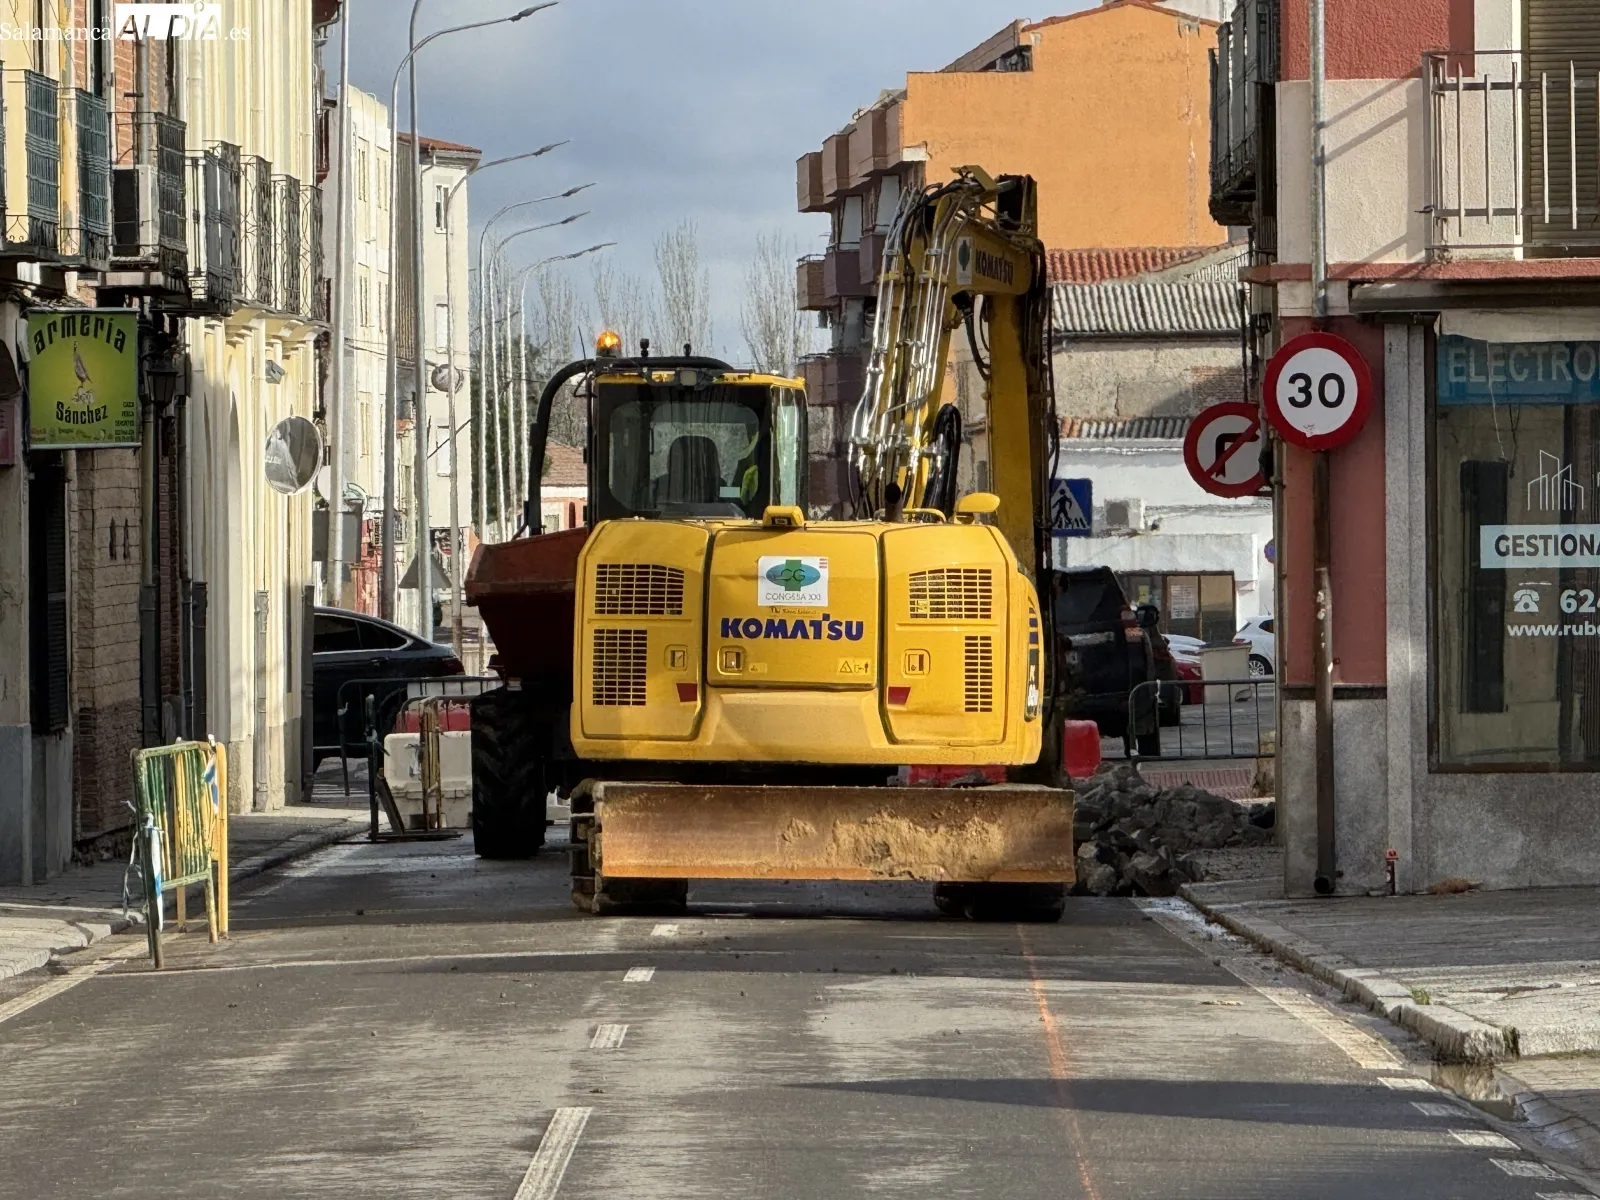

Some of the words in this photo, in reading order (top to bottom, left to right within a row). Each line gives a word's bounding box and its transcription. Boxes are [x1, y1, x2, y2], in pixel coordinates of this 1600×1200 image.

[975, 247, 1014, 286] KOMATSU
[1449, 343, 1600, 382] ELECTRO
[1287, 372, 1346, 409] 30
[55, 400, 109, 425] Sánchez
[1494, 533, 1600, 557] GESTION
[1560, 588, 1600, 614] 62
[720, 613, 864, 641] KOMATSU
